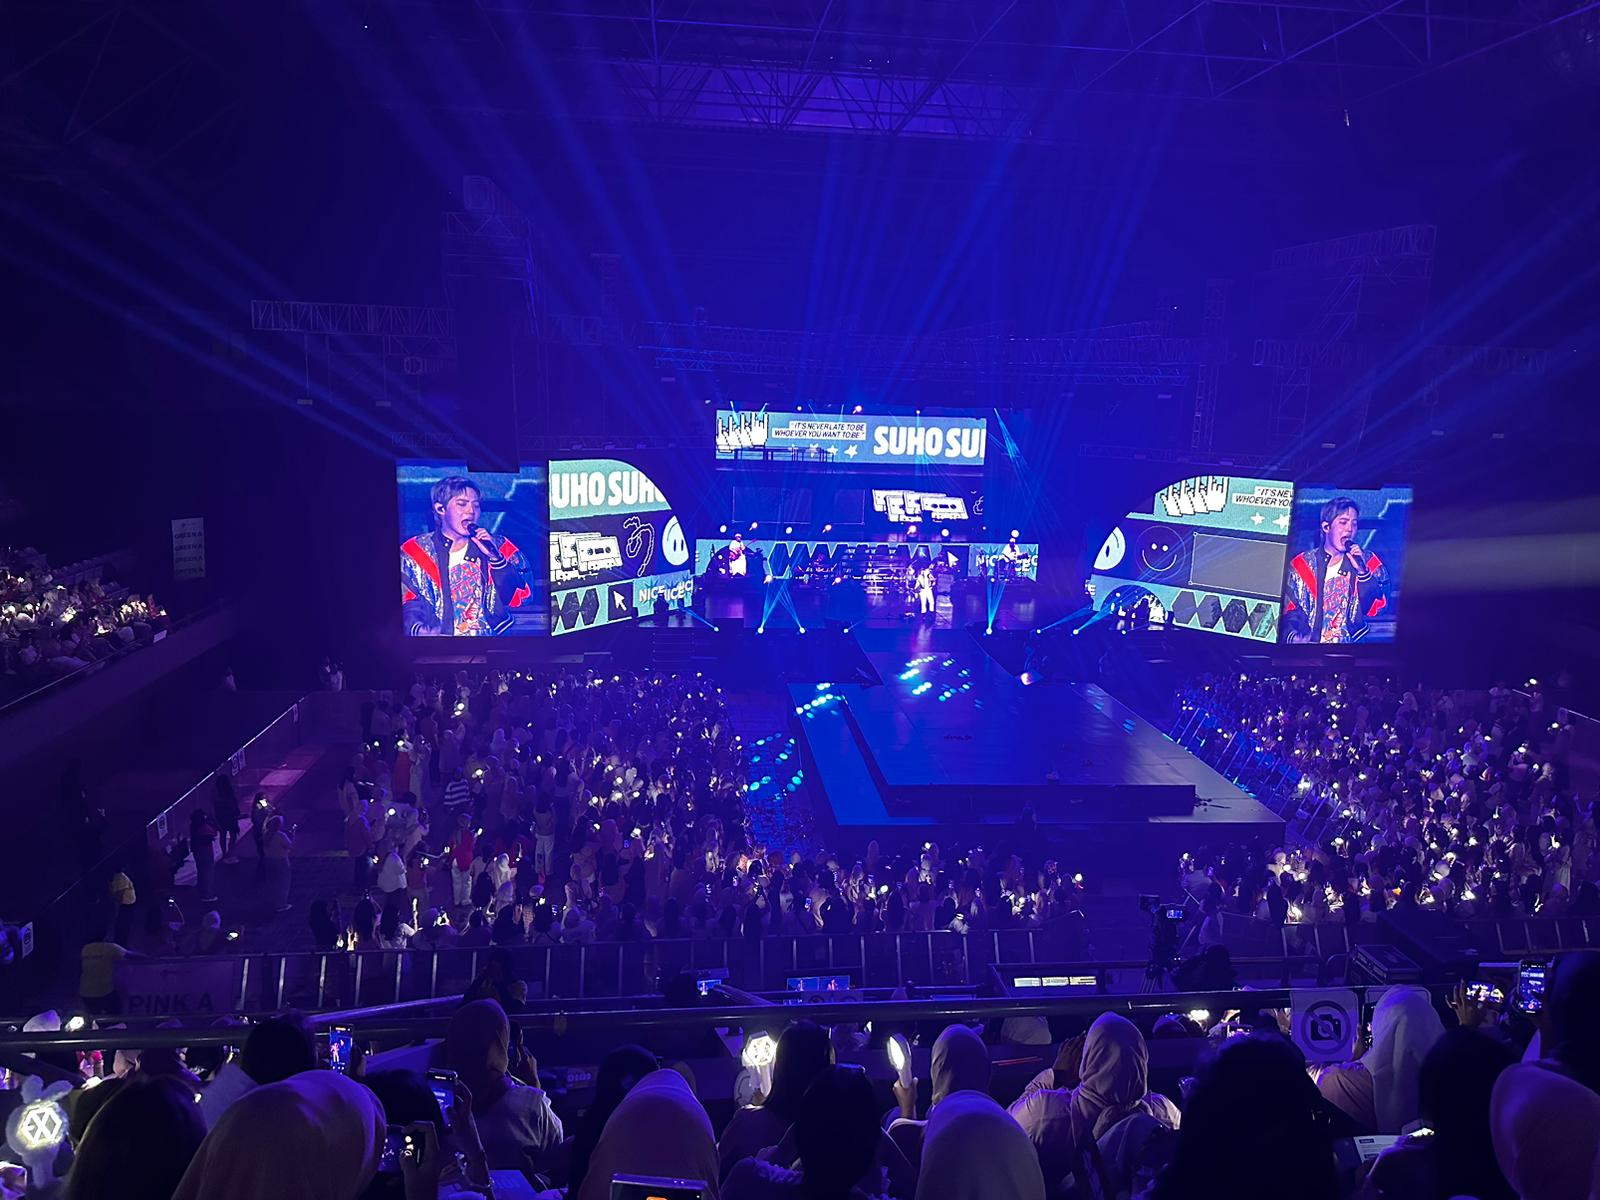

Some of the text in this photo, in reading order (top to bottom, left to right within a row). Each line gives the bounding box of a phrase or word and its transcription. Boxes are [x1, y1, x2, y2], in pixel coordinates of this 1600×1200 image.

[808, 422, 830, 430] NEVER
[830, 423, 844, 431] LATE
[856, 424, 865, 432] BE
[774, 429, 808, 437] WHOEVER
[873, 425, 943, 456] SUHO
[1235, 495, 1277, 505] WHOEVER
[128, 992, 214, 1014] PINK A
